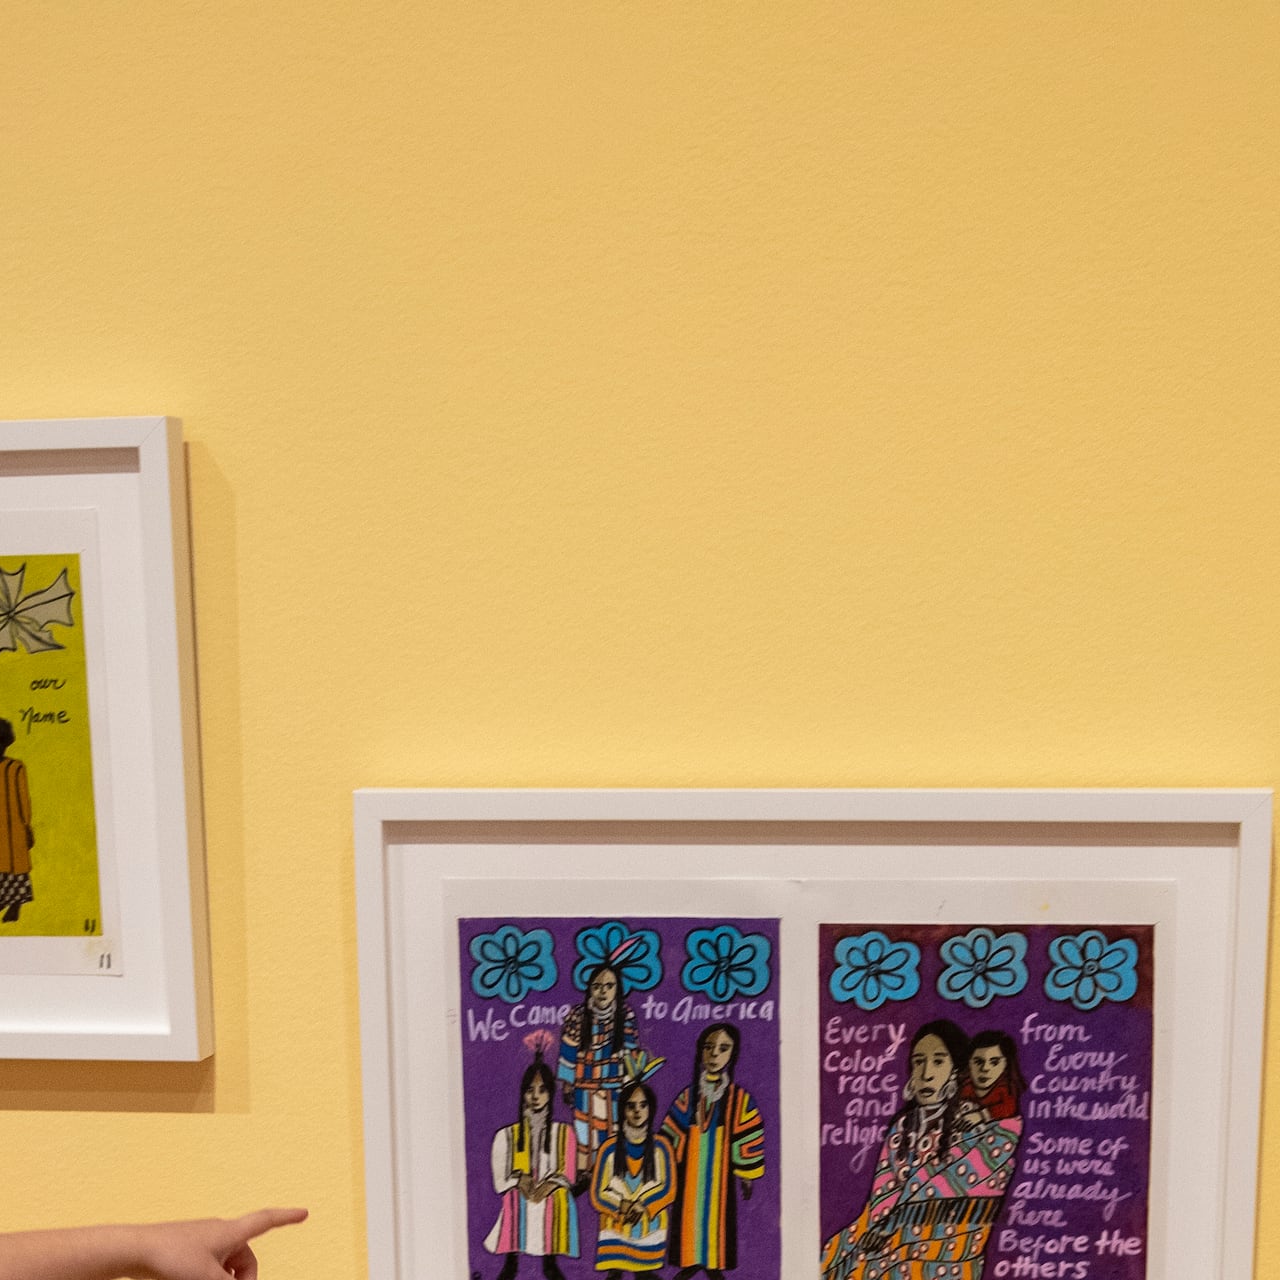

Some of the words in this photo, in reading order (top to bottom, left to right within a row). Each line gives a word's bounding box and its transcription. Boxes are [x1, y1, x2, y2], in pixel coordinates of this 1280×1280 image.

[30, 678, 67, 691] our
[84, 918, 97, 934] 11
[99, 953, 112, 970] 11
[467, 1007, 510, 1042] We
[509, 1004, 571, 1028] Came
[641, 994, 668, 1020] to
[824, 1015, 907, 1057] Every
[823, 1049, 896, 1073] Color
[1044, 1043, 1129, 1072] Every
[837, 1073, 900, 1095] race
[1029, 1070, 1141, 1100] Country
[844, 1092, 899, 1118] and
[1025, 1131, 1094, 1156] Some
[1096, 1135, 1130, 1161] of
[1022, 1158, 1051, 1176] us
[1055, 1158, 1115, 1177] were
[1012, 1177, 1133, 1222] already
[1007, 1200, 1068, 1228] here
[998, 1228, 1091, 1263] Before
[1094, 1229, 1143, 1257] the
[993, 1255, 1091, 1280] others
